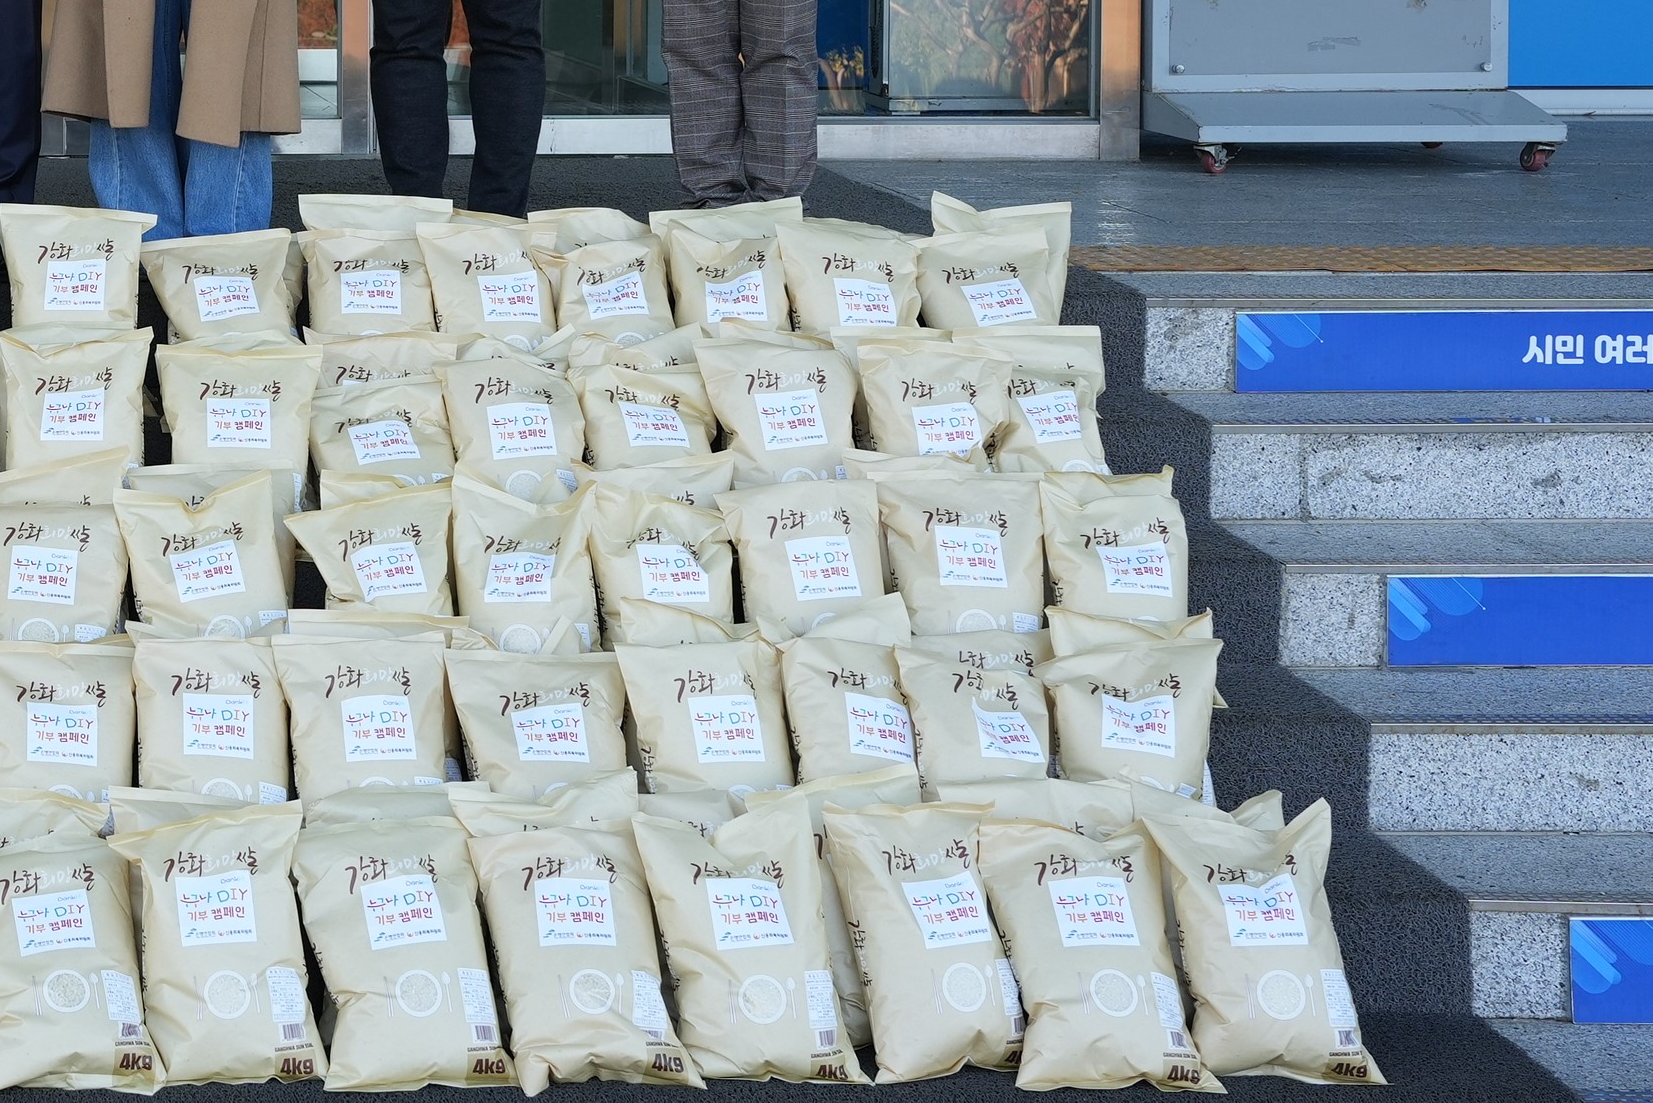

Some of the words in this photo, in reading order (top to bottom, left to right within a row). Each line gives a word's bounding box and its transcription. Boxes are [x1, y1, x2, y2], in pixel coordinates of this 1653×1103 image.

[1522, 334, 1585, 365] 시민
[367, 894, 399, 911] 누구나
[403, 891, 433, 906] DIY
[1225, 895, 1259, 910] 누구나
[1263, 891, 1294, 907] DIY
[375, 914, 396, 926] 기부
[398, 908, 433, 923] 캠페인
[1235, 908, 1258, 922] 기부
[1260, 908, 1295, 922] 캠페인
[472, 1058, 506, 1075] 4kg
[1331, 1063, 1368, 1078] 4kg
